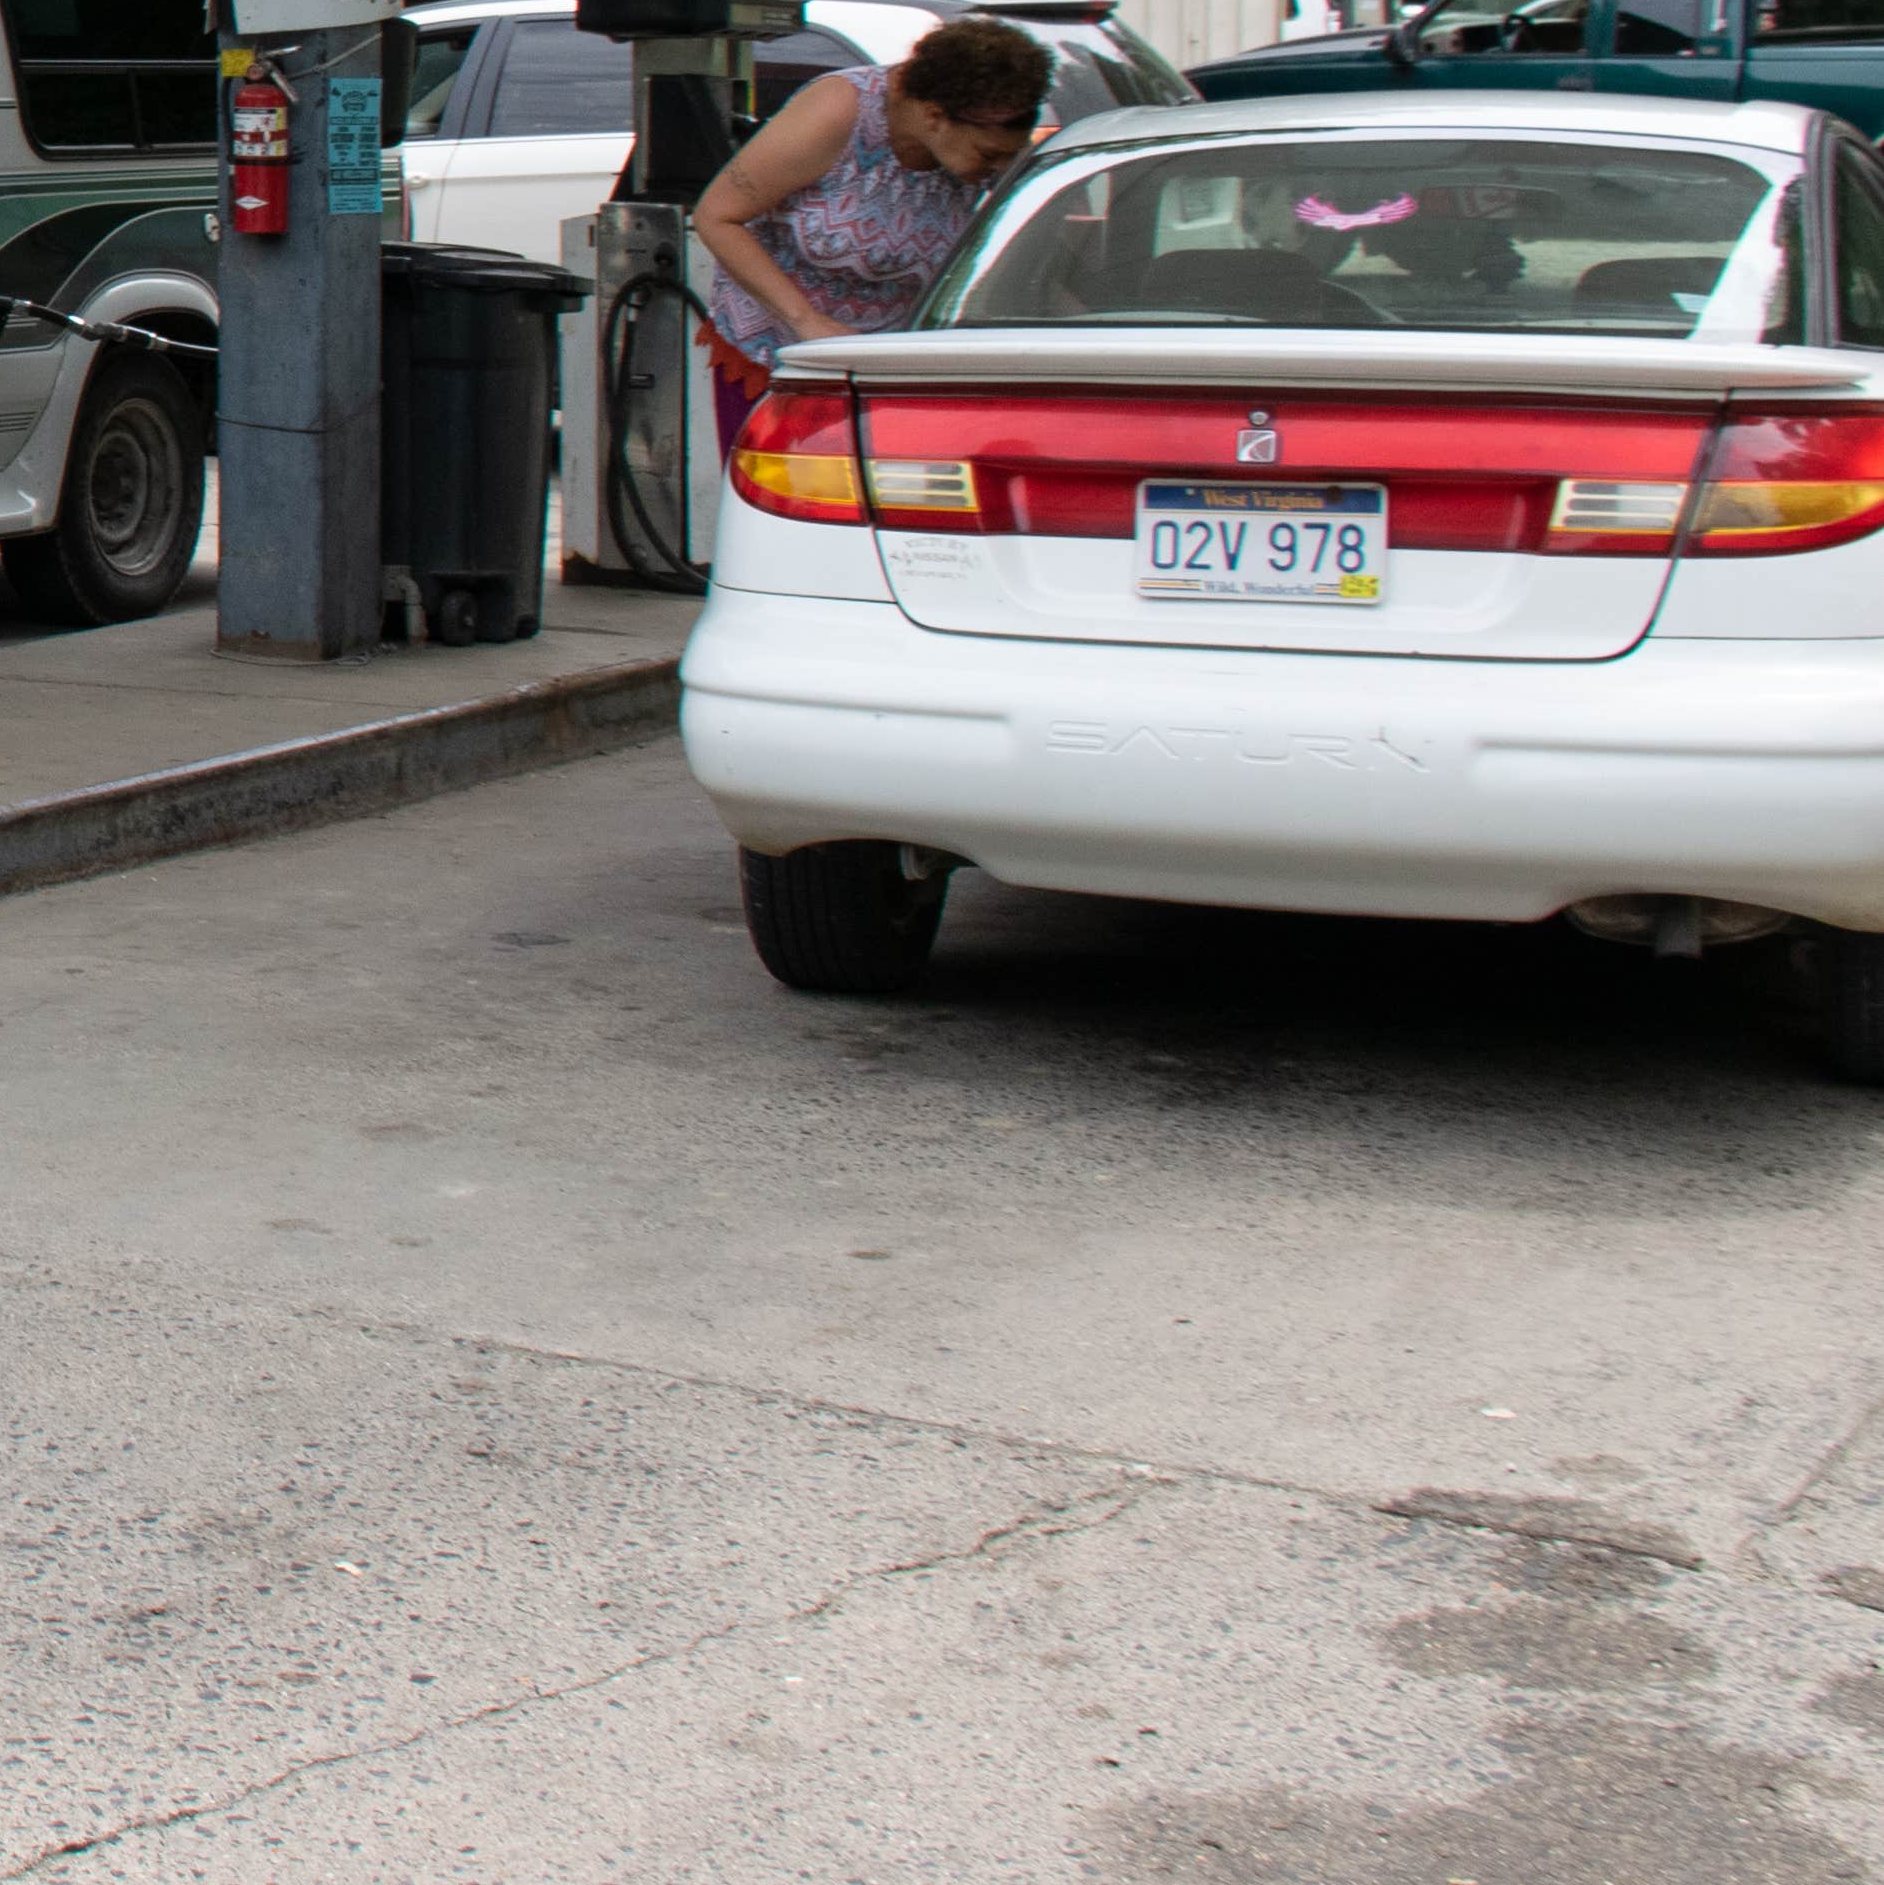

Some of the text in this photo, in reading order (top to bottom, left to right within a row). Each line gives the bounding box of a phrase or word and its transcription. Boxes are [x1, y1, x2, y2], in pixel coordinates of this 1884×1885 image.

[1202, 488, 1326, 511] West Virginia
[1268, 522, 1366, 574] 978
